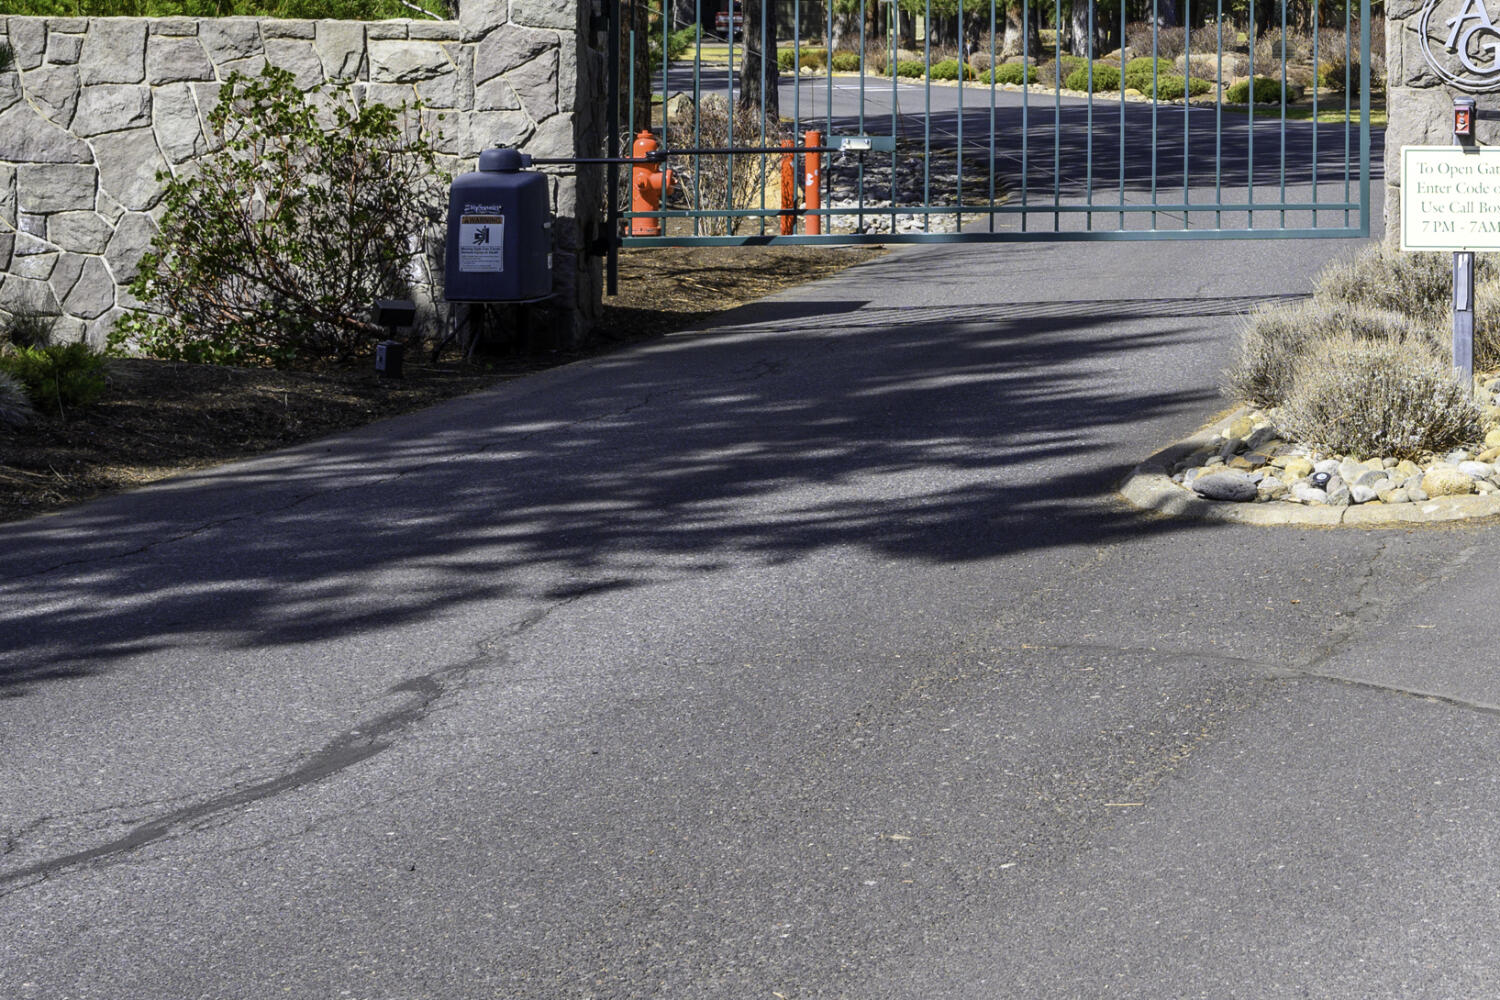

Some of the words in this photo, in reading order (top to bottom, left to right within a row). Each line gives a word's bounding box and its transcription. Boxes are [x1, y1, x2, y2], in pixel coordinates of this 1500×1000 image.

[1416, 162, 1434, 174] To
[1437, 162, 1473, 179] Open
[1416, 181, 1452, 194] Enter
[1455, 181, 1490, 194] Code
[1421, 201, 1445, 213] Use
[1449, 201, 1474, 213] Call
